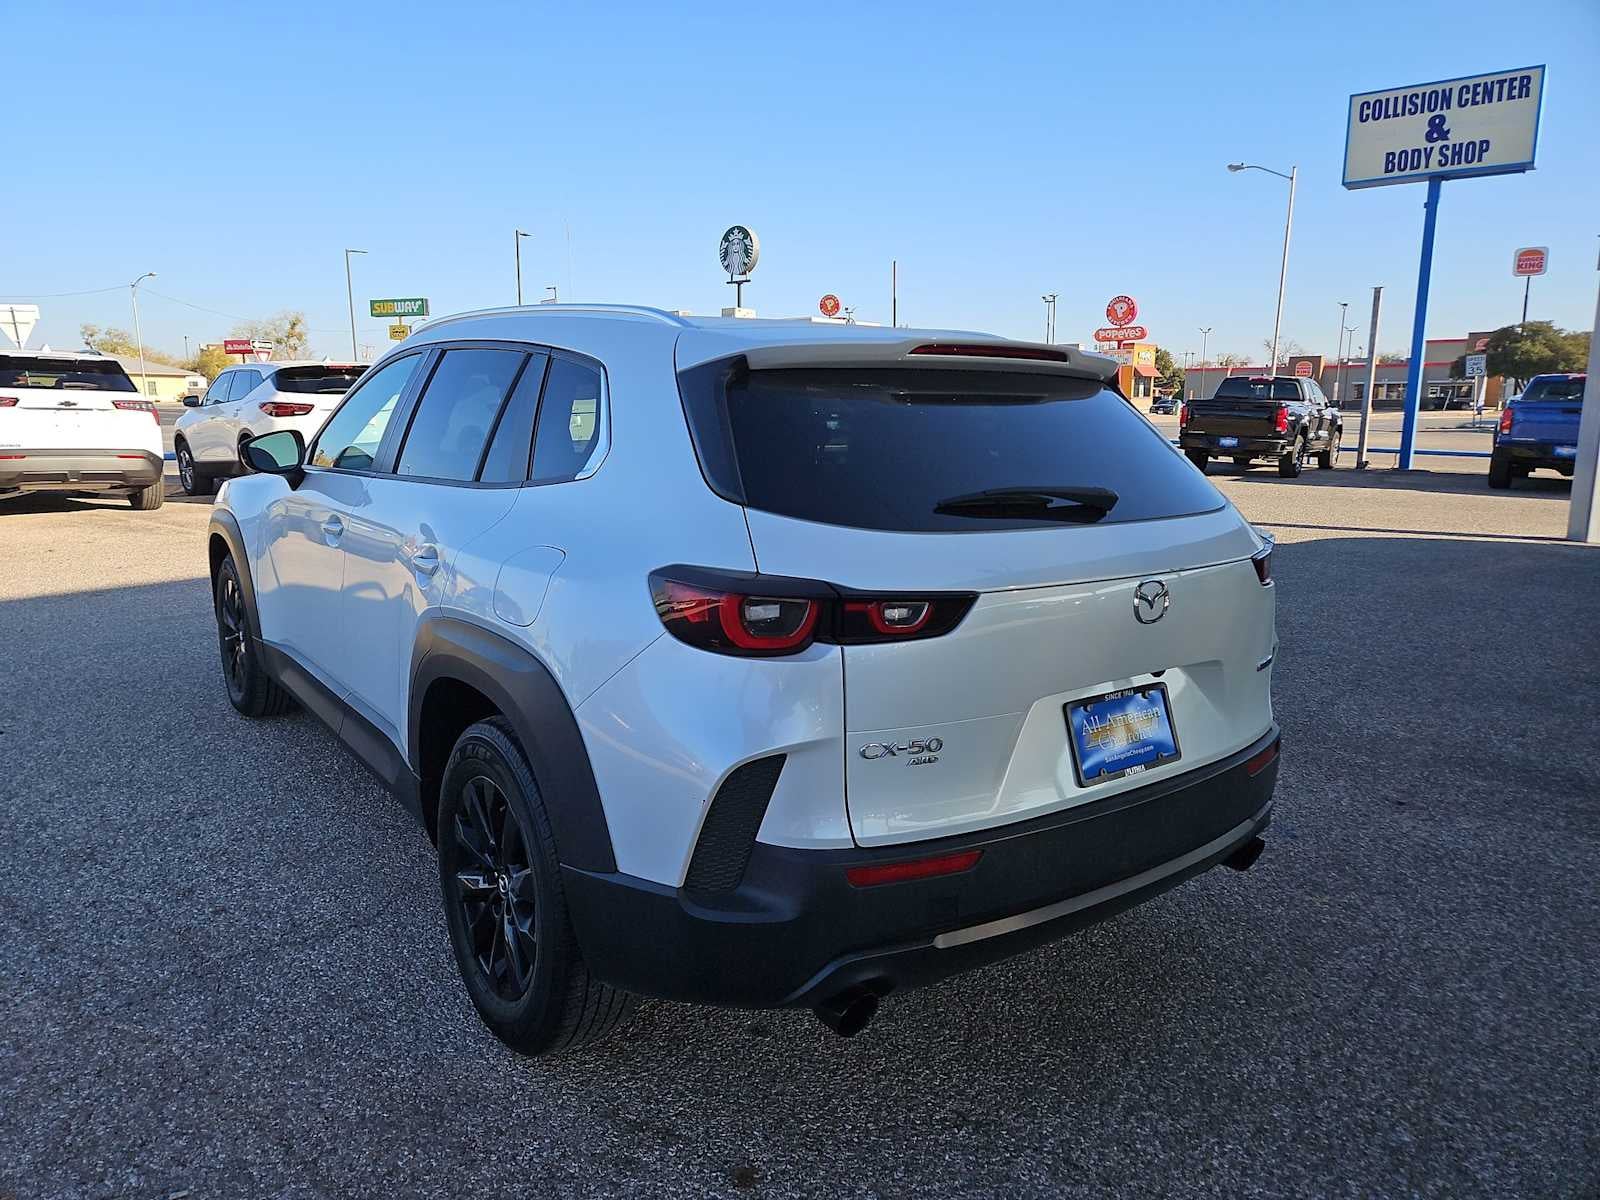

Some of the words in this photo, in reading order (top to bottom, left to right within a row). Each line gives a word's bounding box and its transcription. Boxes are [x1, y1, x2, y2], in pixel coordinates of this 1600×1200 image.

[1359, 88, 1453, 123] COLLISION
[1458, 75, 1532, 108] CENTER
[1425, 114, 1450, 143] &
[1384, 147, 1435, 174] BODY
[1438, 140, 1490, 167] SHOP
[1517, 261, 1544, 269] KING
[373, 301, 421, 313] SUBWAY
[1468, 367, 1483, 375] 35
[1081, 714, 1101, 736] All
[1106, 706, 1161, 729] American
[859, 737, 943, 760] CX-50
[906, 756, 939, 767] AWD
